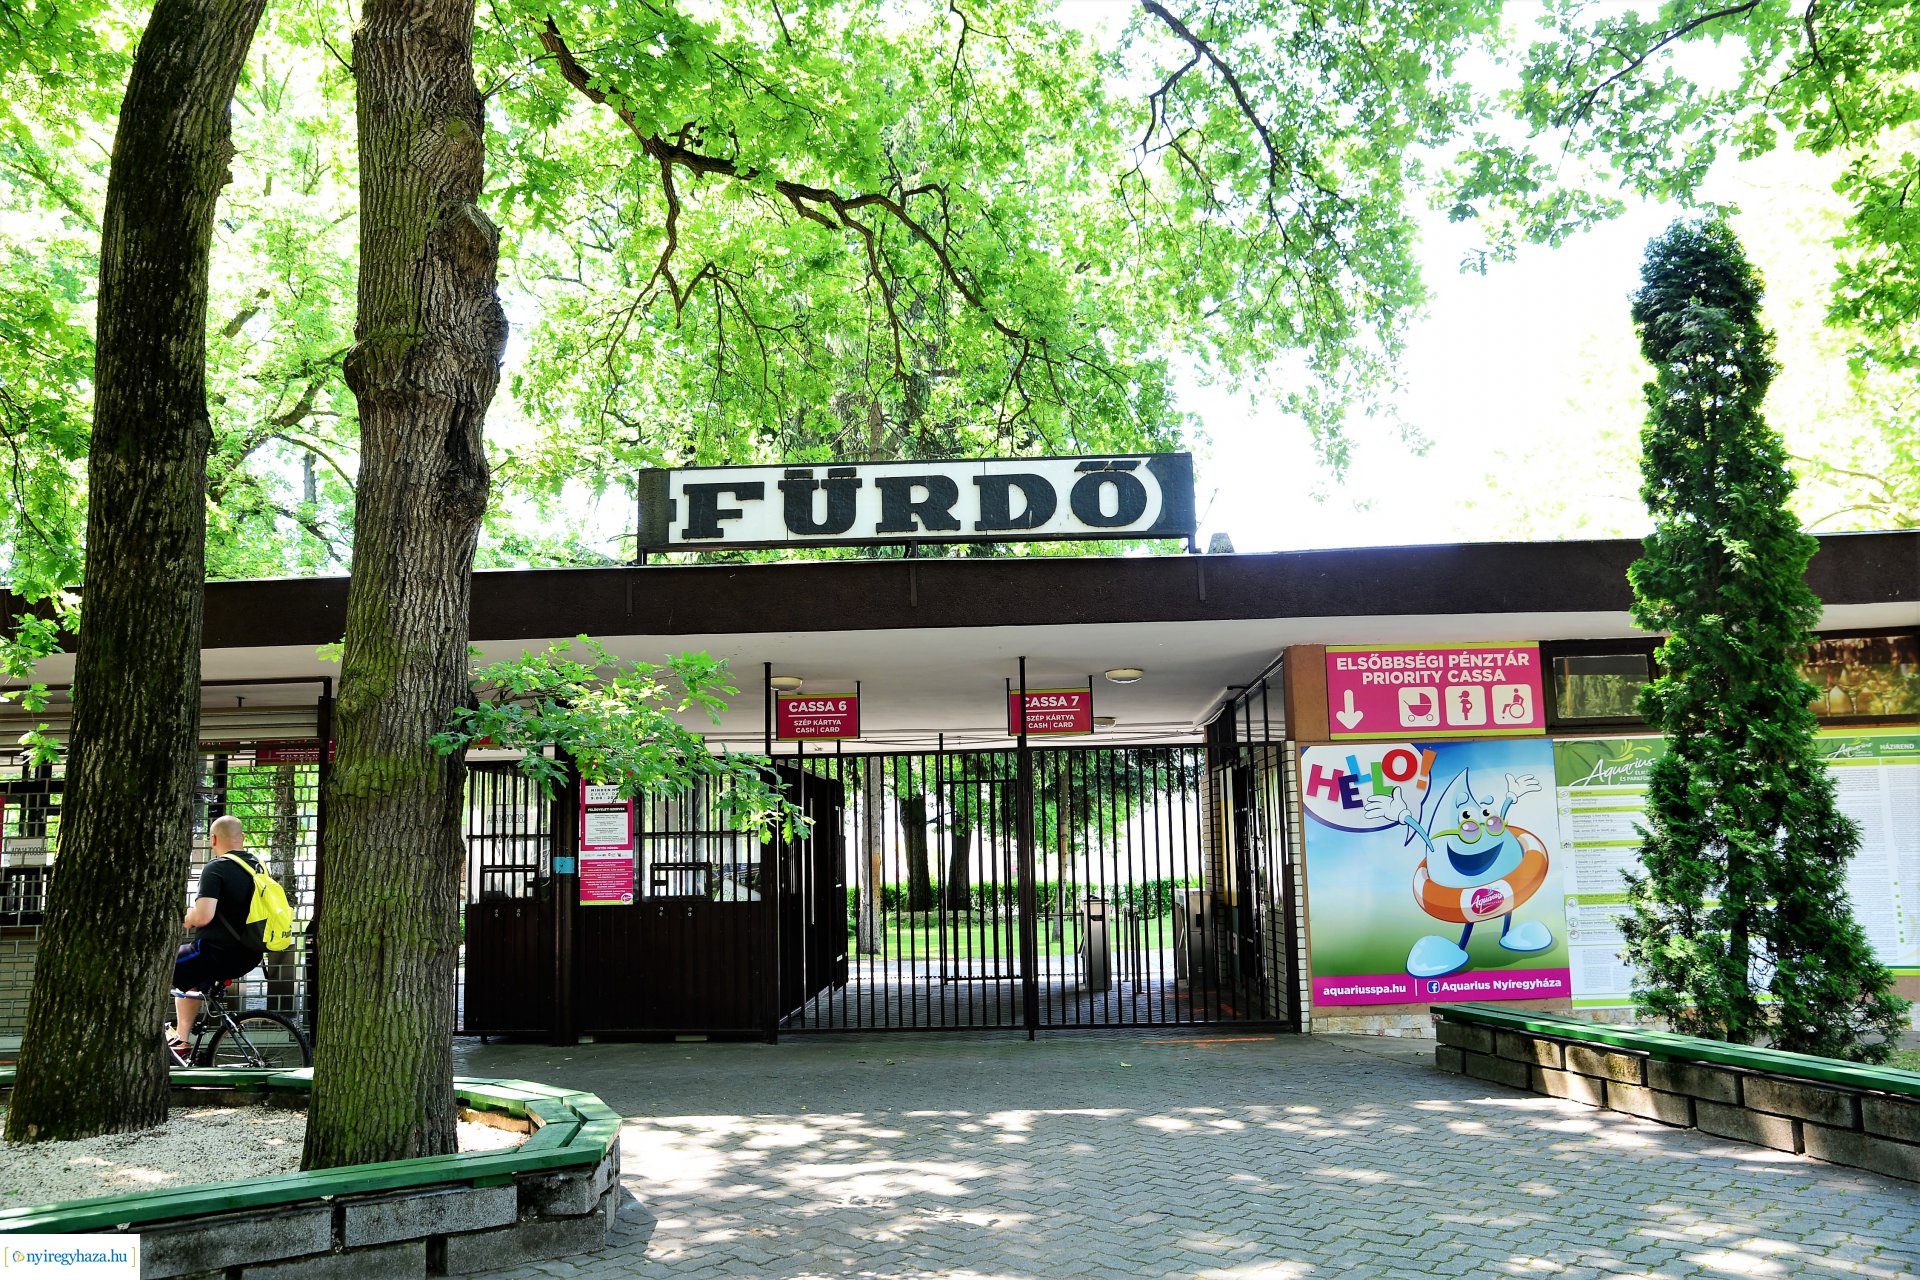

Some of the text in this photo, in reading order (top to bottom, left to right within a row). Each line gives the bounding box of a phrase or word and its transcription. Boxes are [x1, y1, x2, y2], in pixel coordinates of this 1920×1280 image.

[682, 460, 1147, 539] FÜRDŐ
[1336, 650, 1530, 671] ELSŐBBSÉGI PÉNZTÁR
[1362, 669, 1506, 685] PRIORITY CASSA
[788, 700, 847, 713] CASSA 6
[1071, 695, 1080, 706] 7
[793, 718, 842, 727] SZÉP KÁRTYA
[1026, 713, 1075, 722] SZÉP KÁRTYA
[1306, 748, 1437, 810] HELLO!
[1568, 757, 1658, 787] Aquarius
[1323, 983, 1407, 997] aquariusspa.hu
[1441, 980, 1491, 993] Aquarius
[1492, 978, 1562, 991] Nyíregyháza
